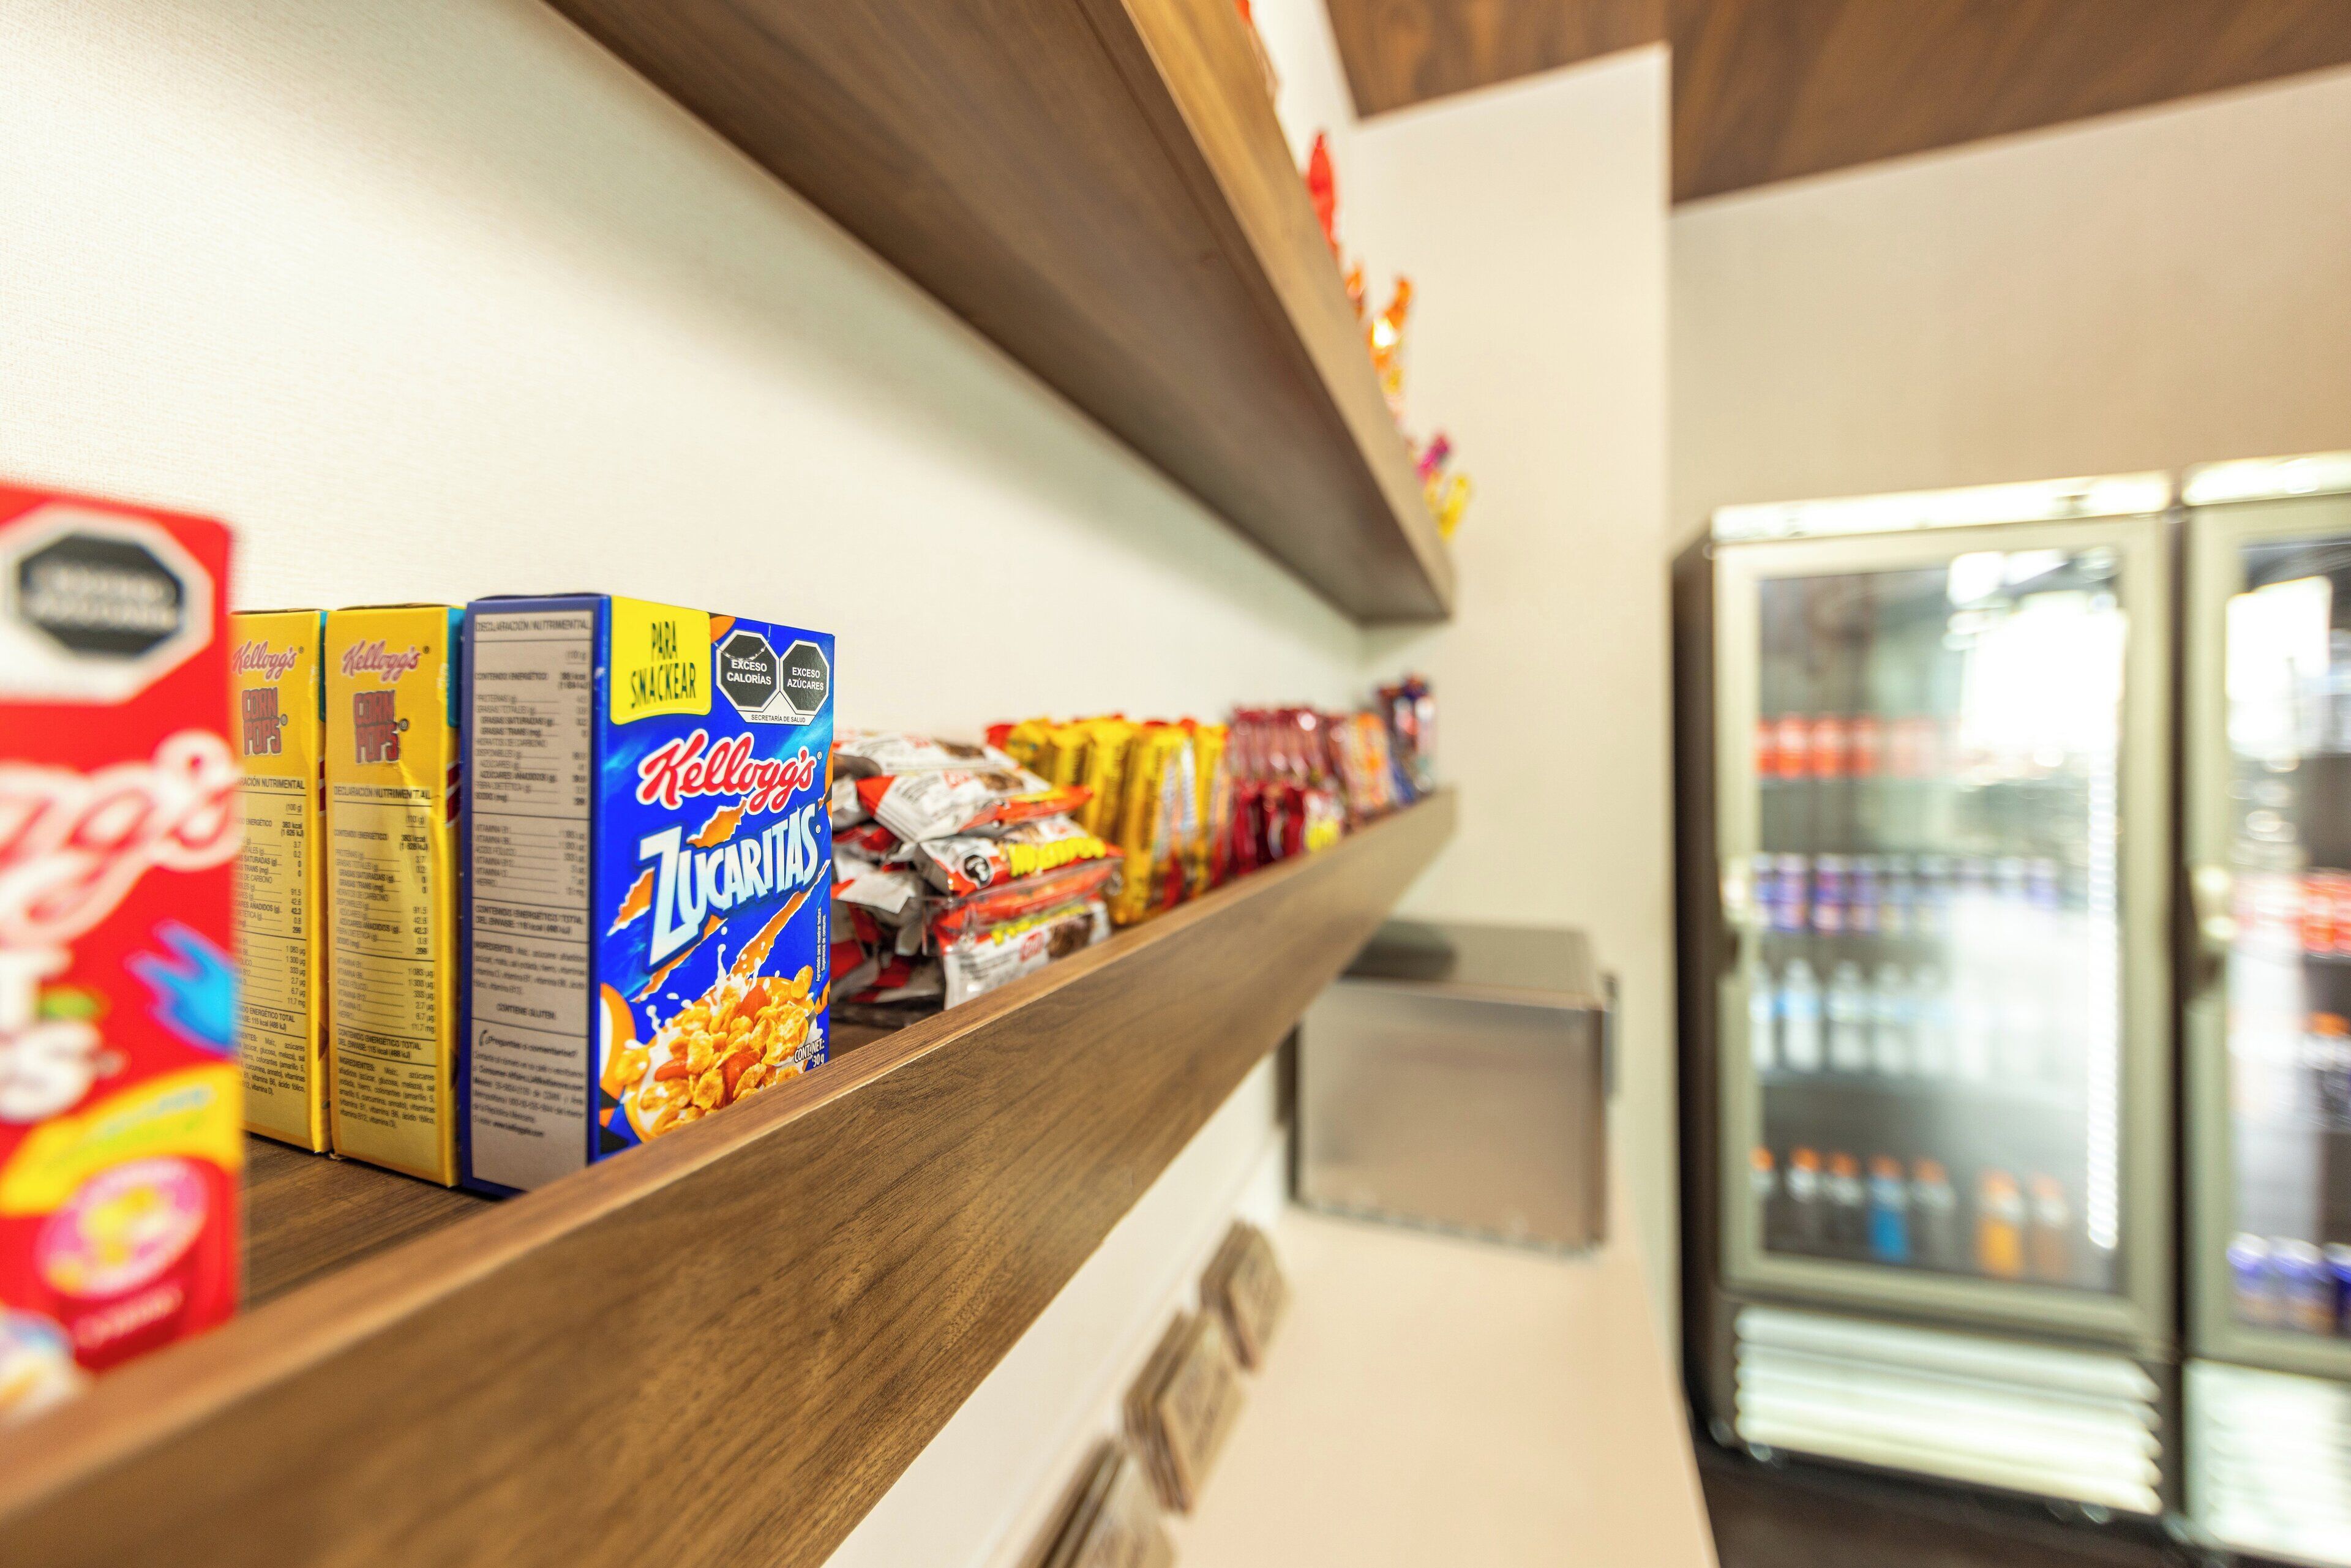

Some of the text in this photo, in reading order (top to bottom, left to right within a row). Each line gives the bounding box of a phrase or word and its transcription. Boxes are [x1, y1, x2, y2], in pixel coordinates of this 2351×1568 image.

[651, 621, 677, 662] PARA
[232, 640, 298, 681] Kellogg's
[342, 640, 421, 683] Kellogg's
[731, 660, 767, 672] EXCESO
[792, 667, 820, 679] EXCESO
[631, 662, 697, 708] SNACKEAR
[726, 672, 772, 686] CALORÍAS
[787, 678, 824, 691] AZÚCARES
[242, 687, 278, 722] CORN
[353, 689, 396, 727] CORN
[244, 720, 282, 757] POPS
[356, 722, 400, 764] POPS
[262, 778, 305, 789] NUTRIMENTAL
[638, 730, 817, 814] Kellogg's
[334, 786, 431, 799] DECLARACIÓN NUTRIMENTAL
[250, 875, 272, 883] CARBONO
[639, 803, 819, 966] ZUCARITAS
[250, 1007, 295, 1022] ENERGÉTICO TOTAL
[794, 1044, 811, 1063] CONT.
[812, 1053, 824, 1067] 30 g
